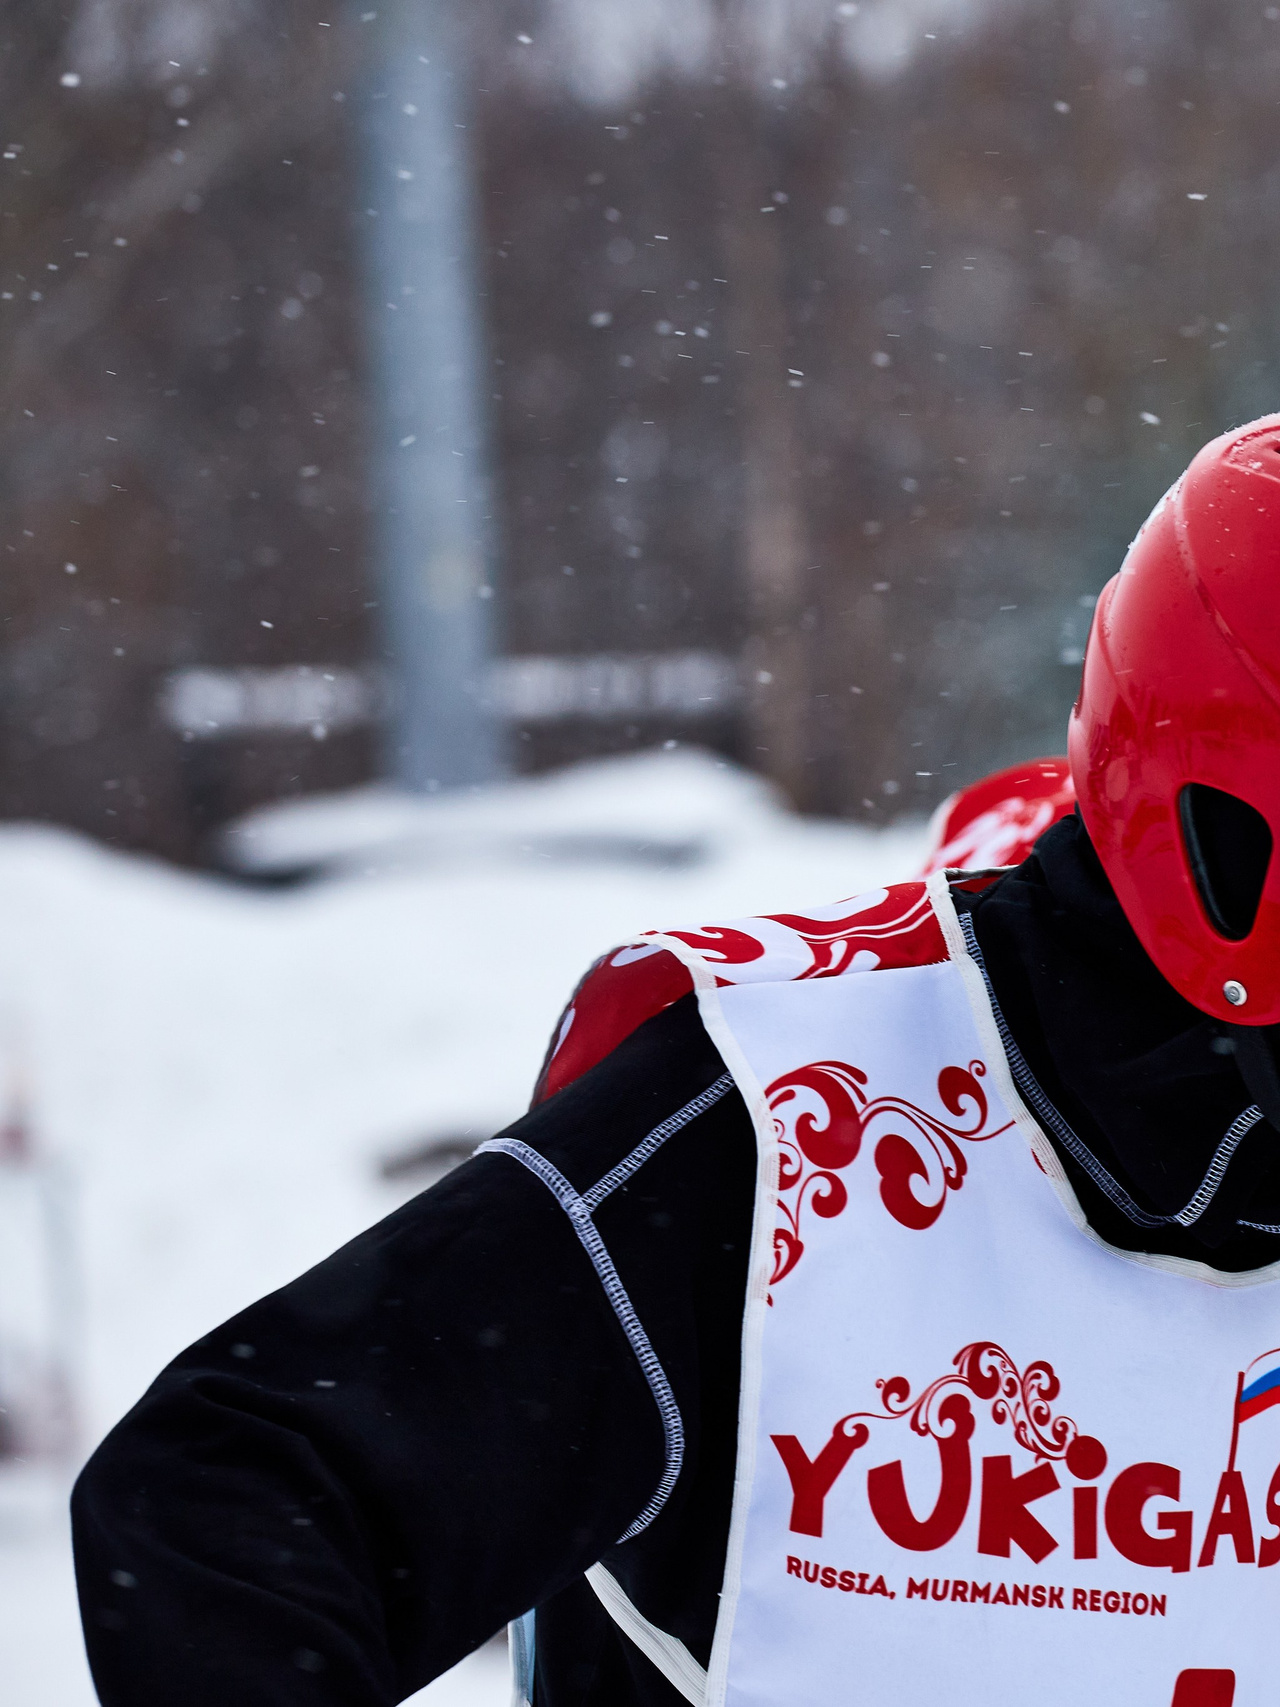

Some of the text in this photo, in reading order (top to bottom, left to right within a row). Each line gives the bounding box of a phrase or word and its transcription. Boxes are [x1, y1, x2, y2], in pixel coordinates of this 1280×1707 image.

[786, 1555, 1168, 1617] RUSSIA, MURMANSK REGION
